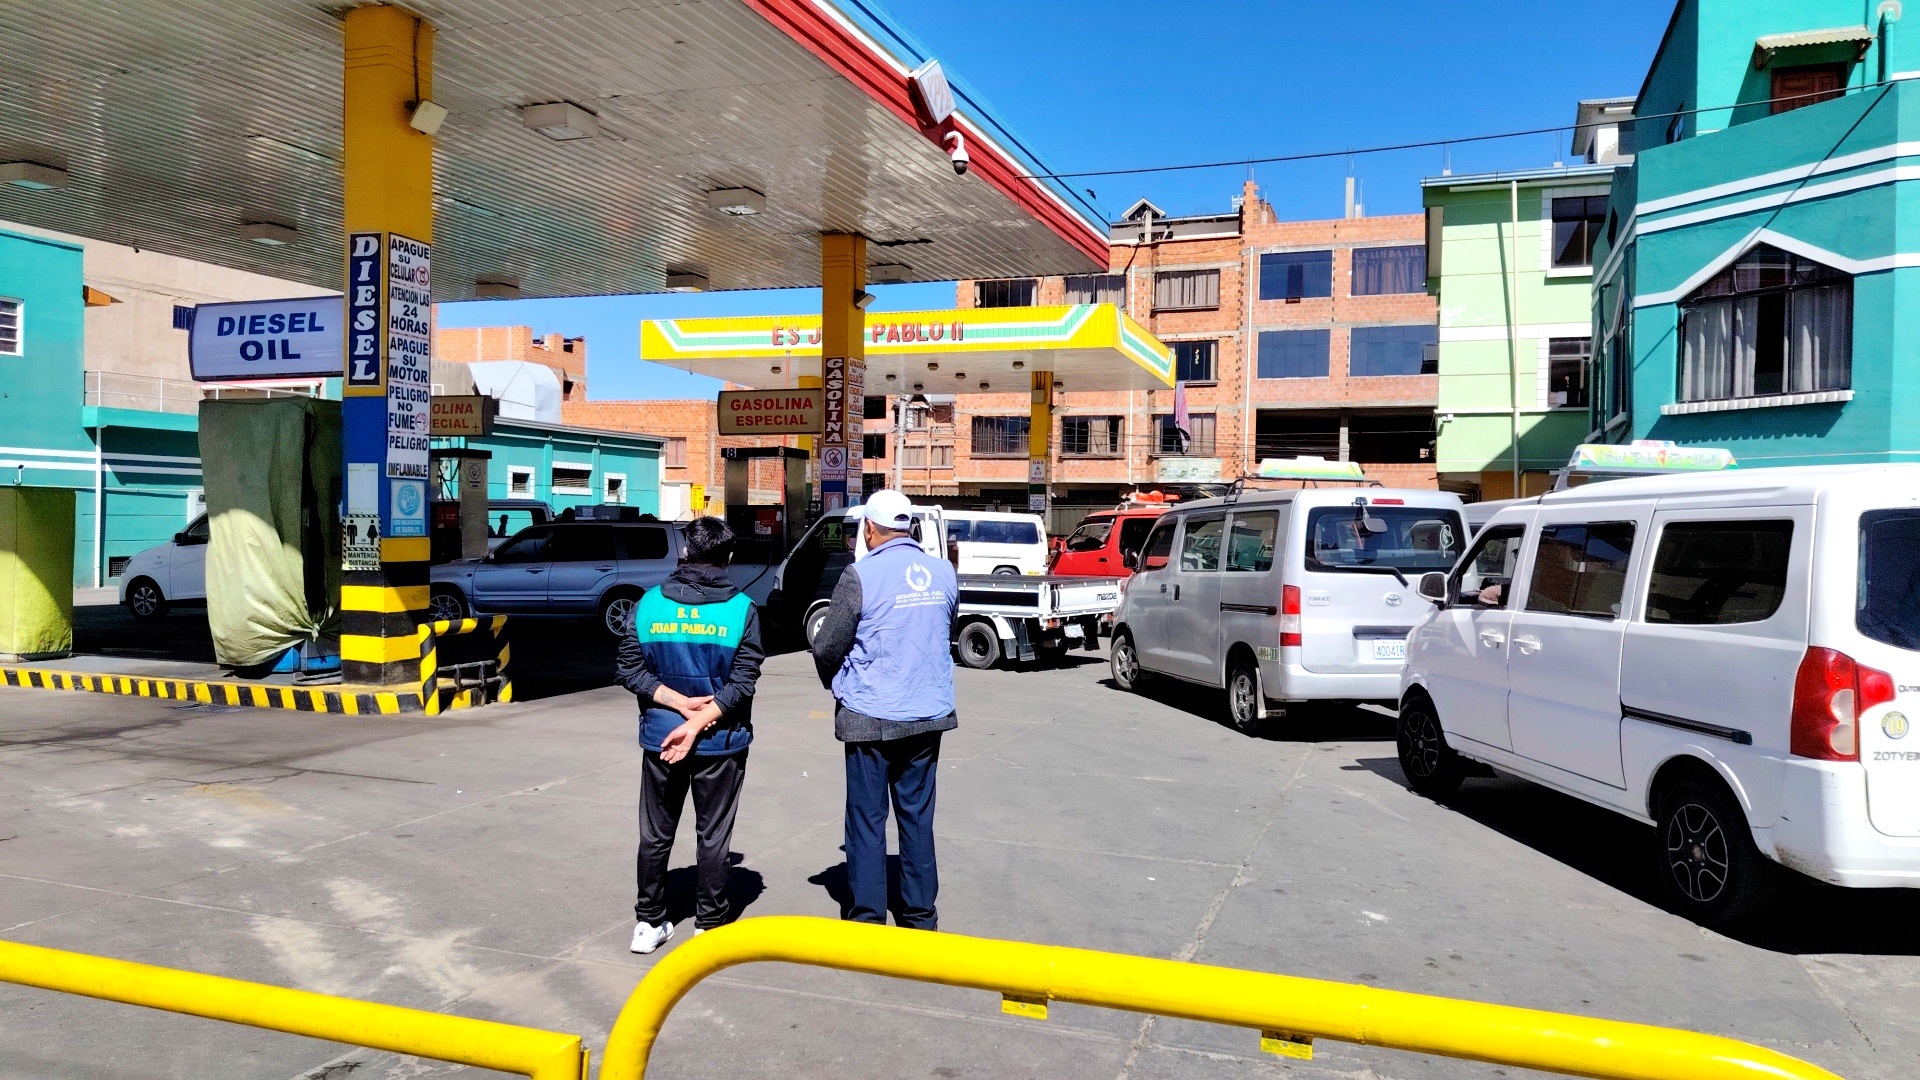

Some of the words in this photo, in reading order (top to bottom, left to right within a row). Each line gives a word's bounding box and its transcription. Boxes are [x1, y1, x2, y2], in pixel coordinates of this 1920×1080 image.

[391, 238, 429, 259] APAGUE
[398, 254, 411, 265] SU
[390, 263, 416, 284] CELULAR
[391, 286, 419, 304] ATENCION
[419, 292, 430, 308] LAS
[352, 236, 379, 380] DIESEL
[402, 304, 418, 319] 24
[217, 311, 325, 337] DIESEL
[390, 315, 428, 336] HORAS
[872, 321, 945, 344] PABLO
[239, 339, 302, 362] OIL
[390, 336, 429, 356] APAGUE
[402, 354, 417, 367] SU
[389, 364, 428, 384] MOTOR
[389, 385, 429, 404] PELIGRO
[825, 358, 844, 442] GASOLINA
[397, 401, 413, 412] NO
[431, 403, 474, 415] OLINA
[730, 397, 814, 412] GASOLINA
[388, 412, 416, 430] FUME
[432, 418, 469, 429] ECIAL
[735, 414, 808, 427] ESPECIAL
[389, 435, 428, 452] PELIGRO
[727, 447, 737, 458] 8
[778, 446, 785, 457] 8
[388, 463, 427, 478] INFLAMABLE
[348, 559, 377, 567] DISTANCIA
[1096, 592, 1117, 601] mazda
[677, 607, 688, 619] E.
[649, 622, 679, 634] JUAN
[681, 623, 717, 636] PABLO
[1376, 645, 1405, 657] 4004IR
[1888, 717, 1906, 736] 19
